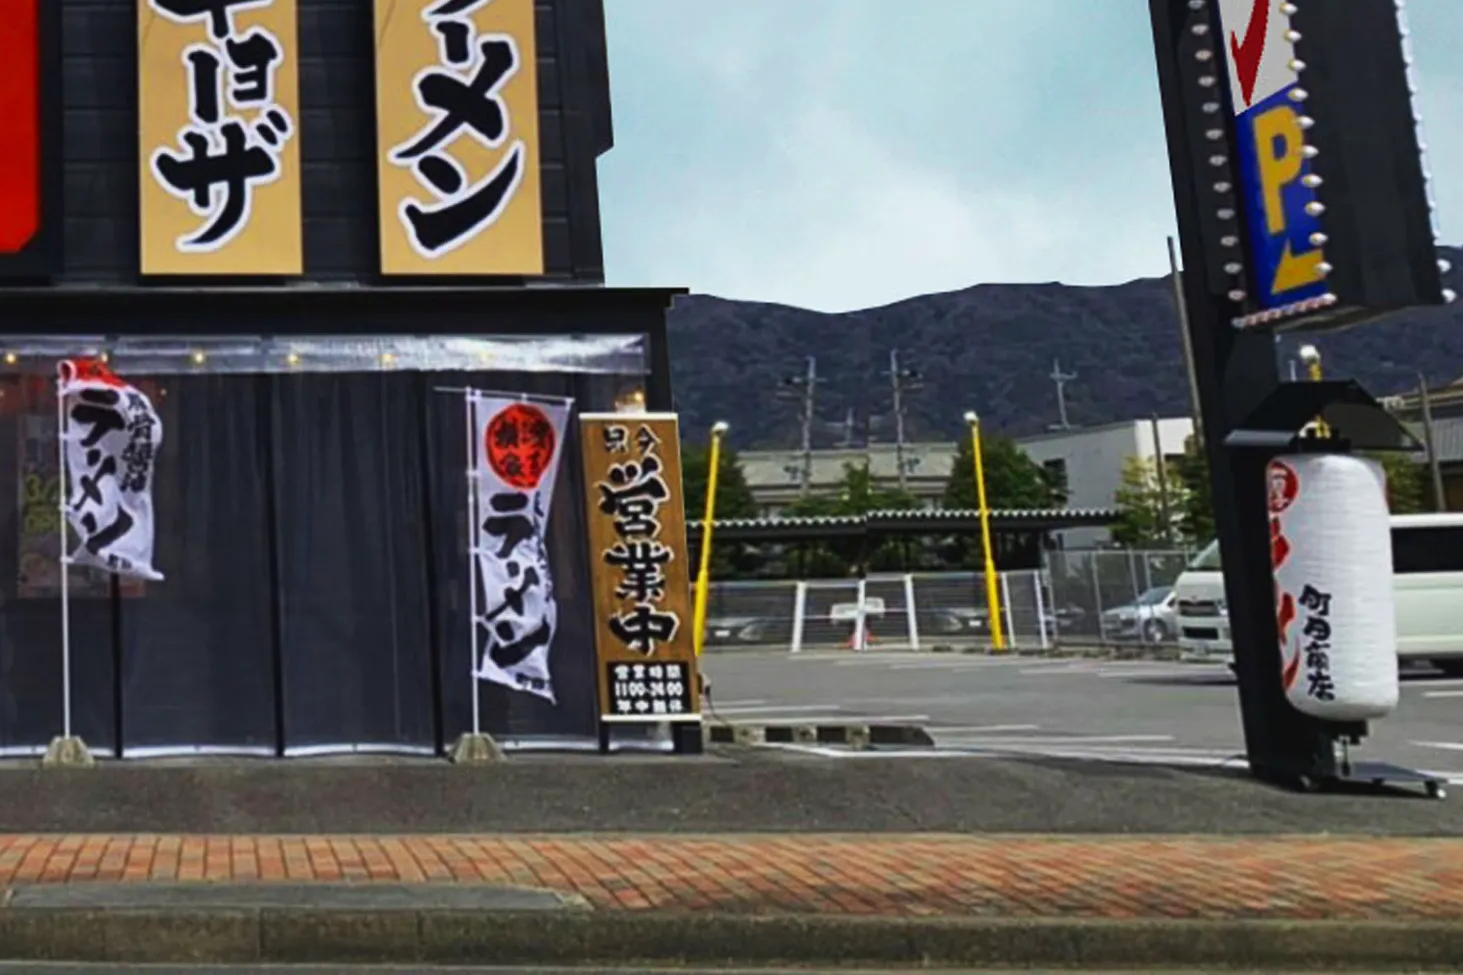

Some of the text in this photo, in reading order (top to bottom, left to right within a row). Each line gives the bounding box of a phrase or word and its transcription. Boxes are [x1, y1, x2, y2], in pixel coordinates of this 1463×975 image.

[1253, 105, 1304, 235] P
[482, 492, 550, 668] ラーメン
[594, 453, 679, 656] 営業中
